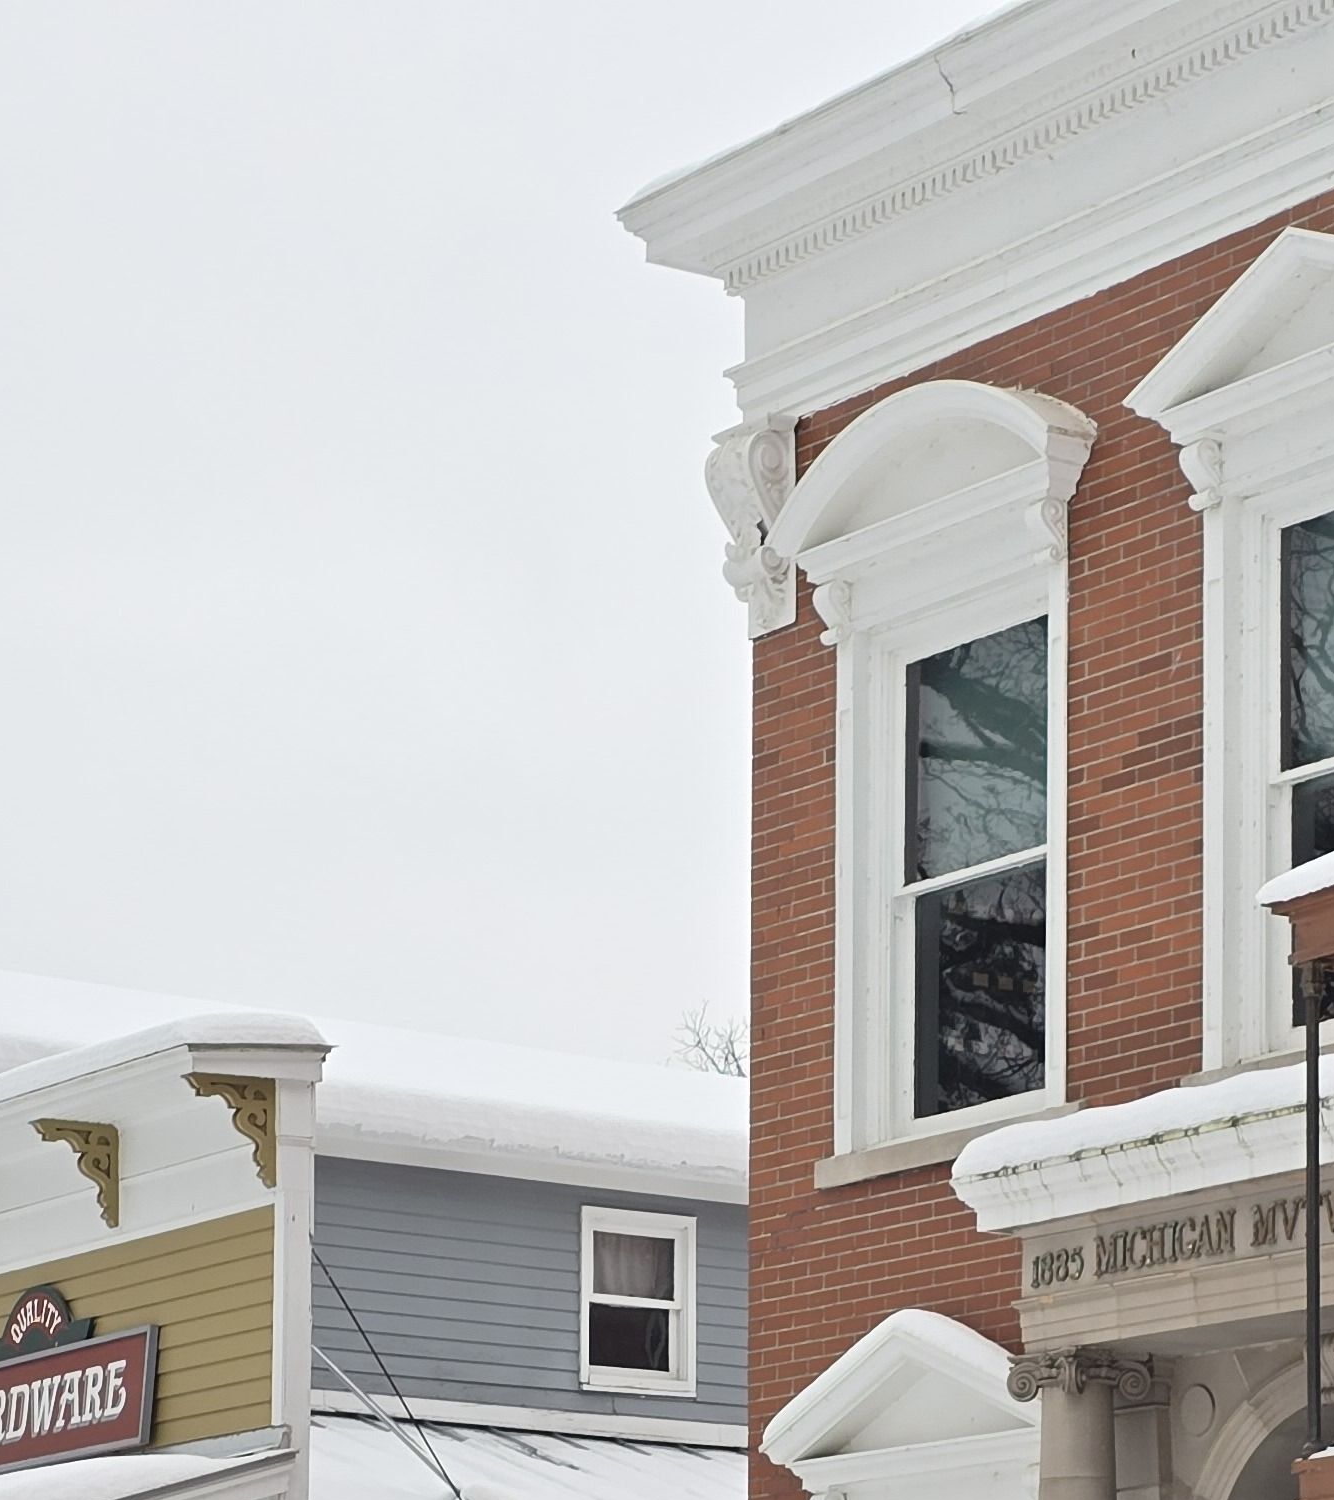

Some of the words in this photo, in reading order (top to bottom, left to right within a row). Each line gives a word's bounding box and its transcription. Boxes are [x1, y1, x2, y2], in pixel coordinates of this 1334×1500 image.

[1030, 1246, 1084, 1288] 1885
[1093, 1207, 1237, 1280] MICHIGAN
[10, 1299, 62, 1344] QUALITY
